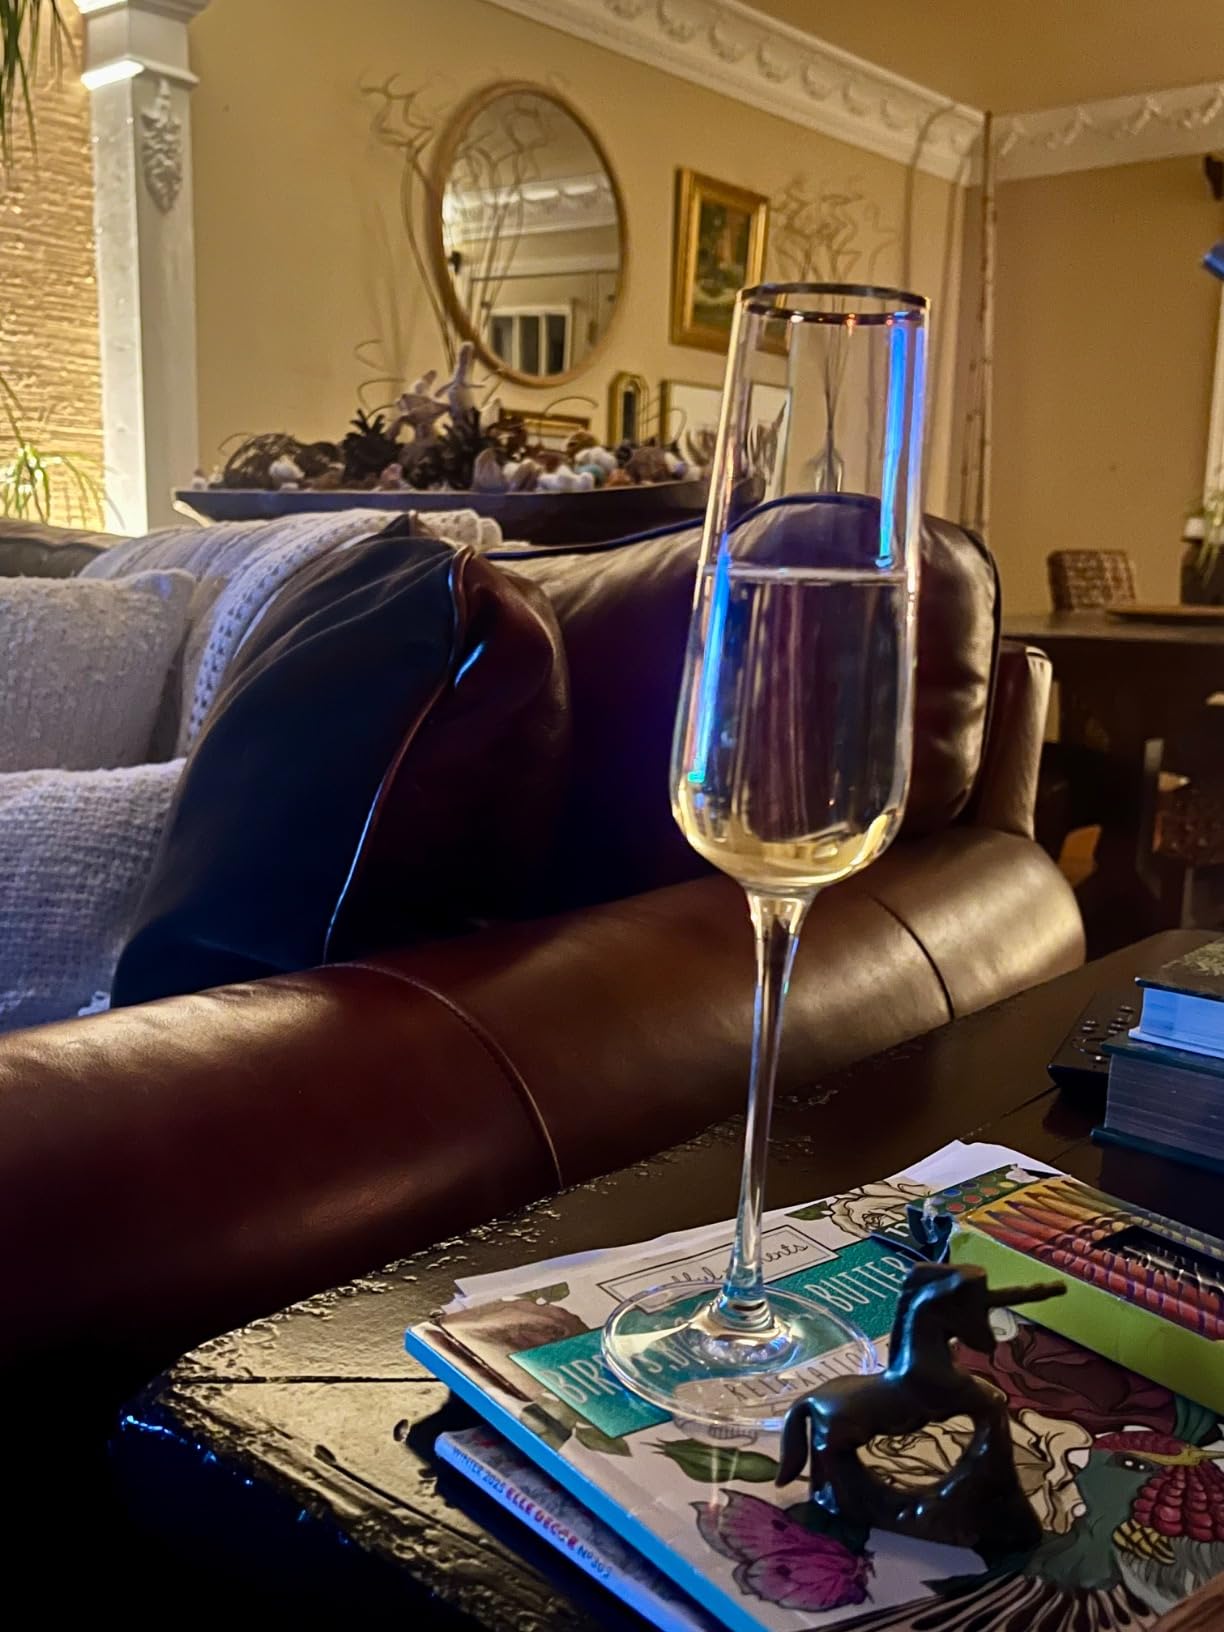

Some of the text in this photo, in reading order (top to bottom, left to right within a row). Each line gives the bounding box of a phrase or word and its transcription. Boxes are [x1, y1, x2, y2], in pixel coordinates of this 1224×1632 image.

[724, 1349, 887, 1402] RELAXATIO
[505, 1486, 536, 1517] ELLE
[534, 1509, 579, 1551] DECOR
